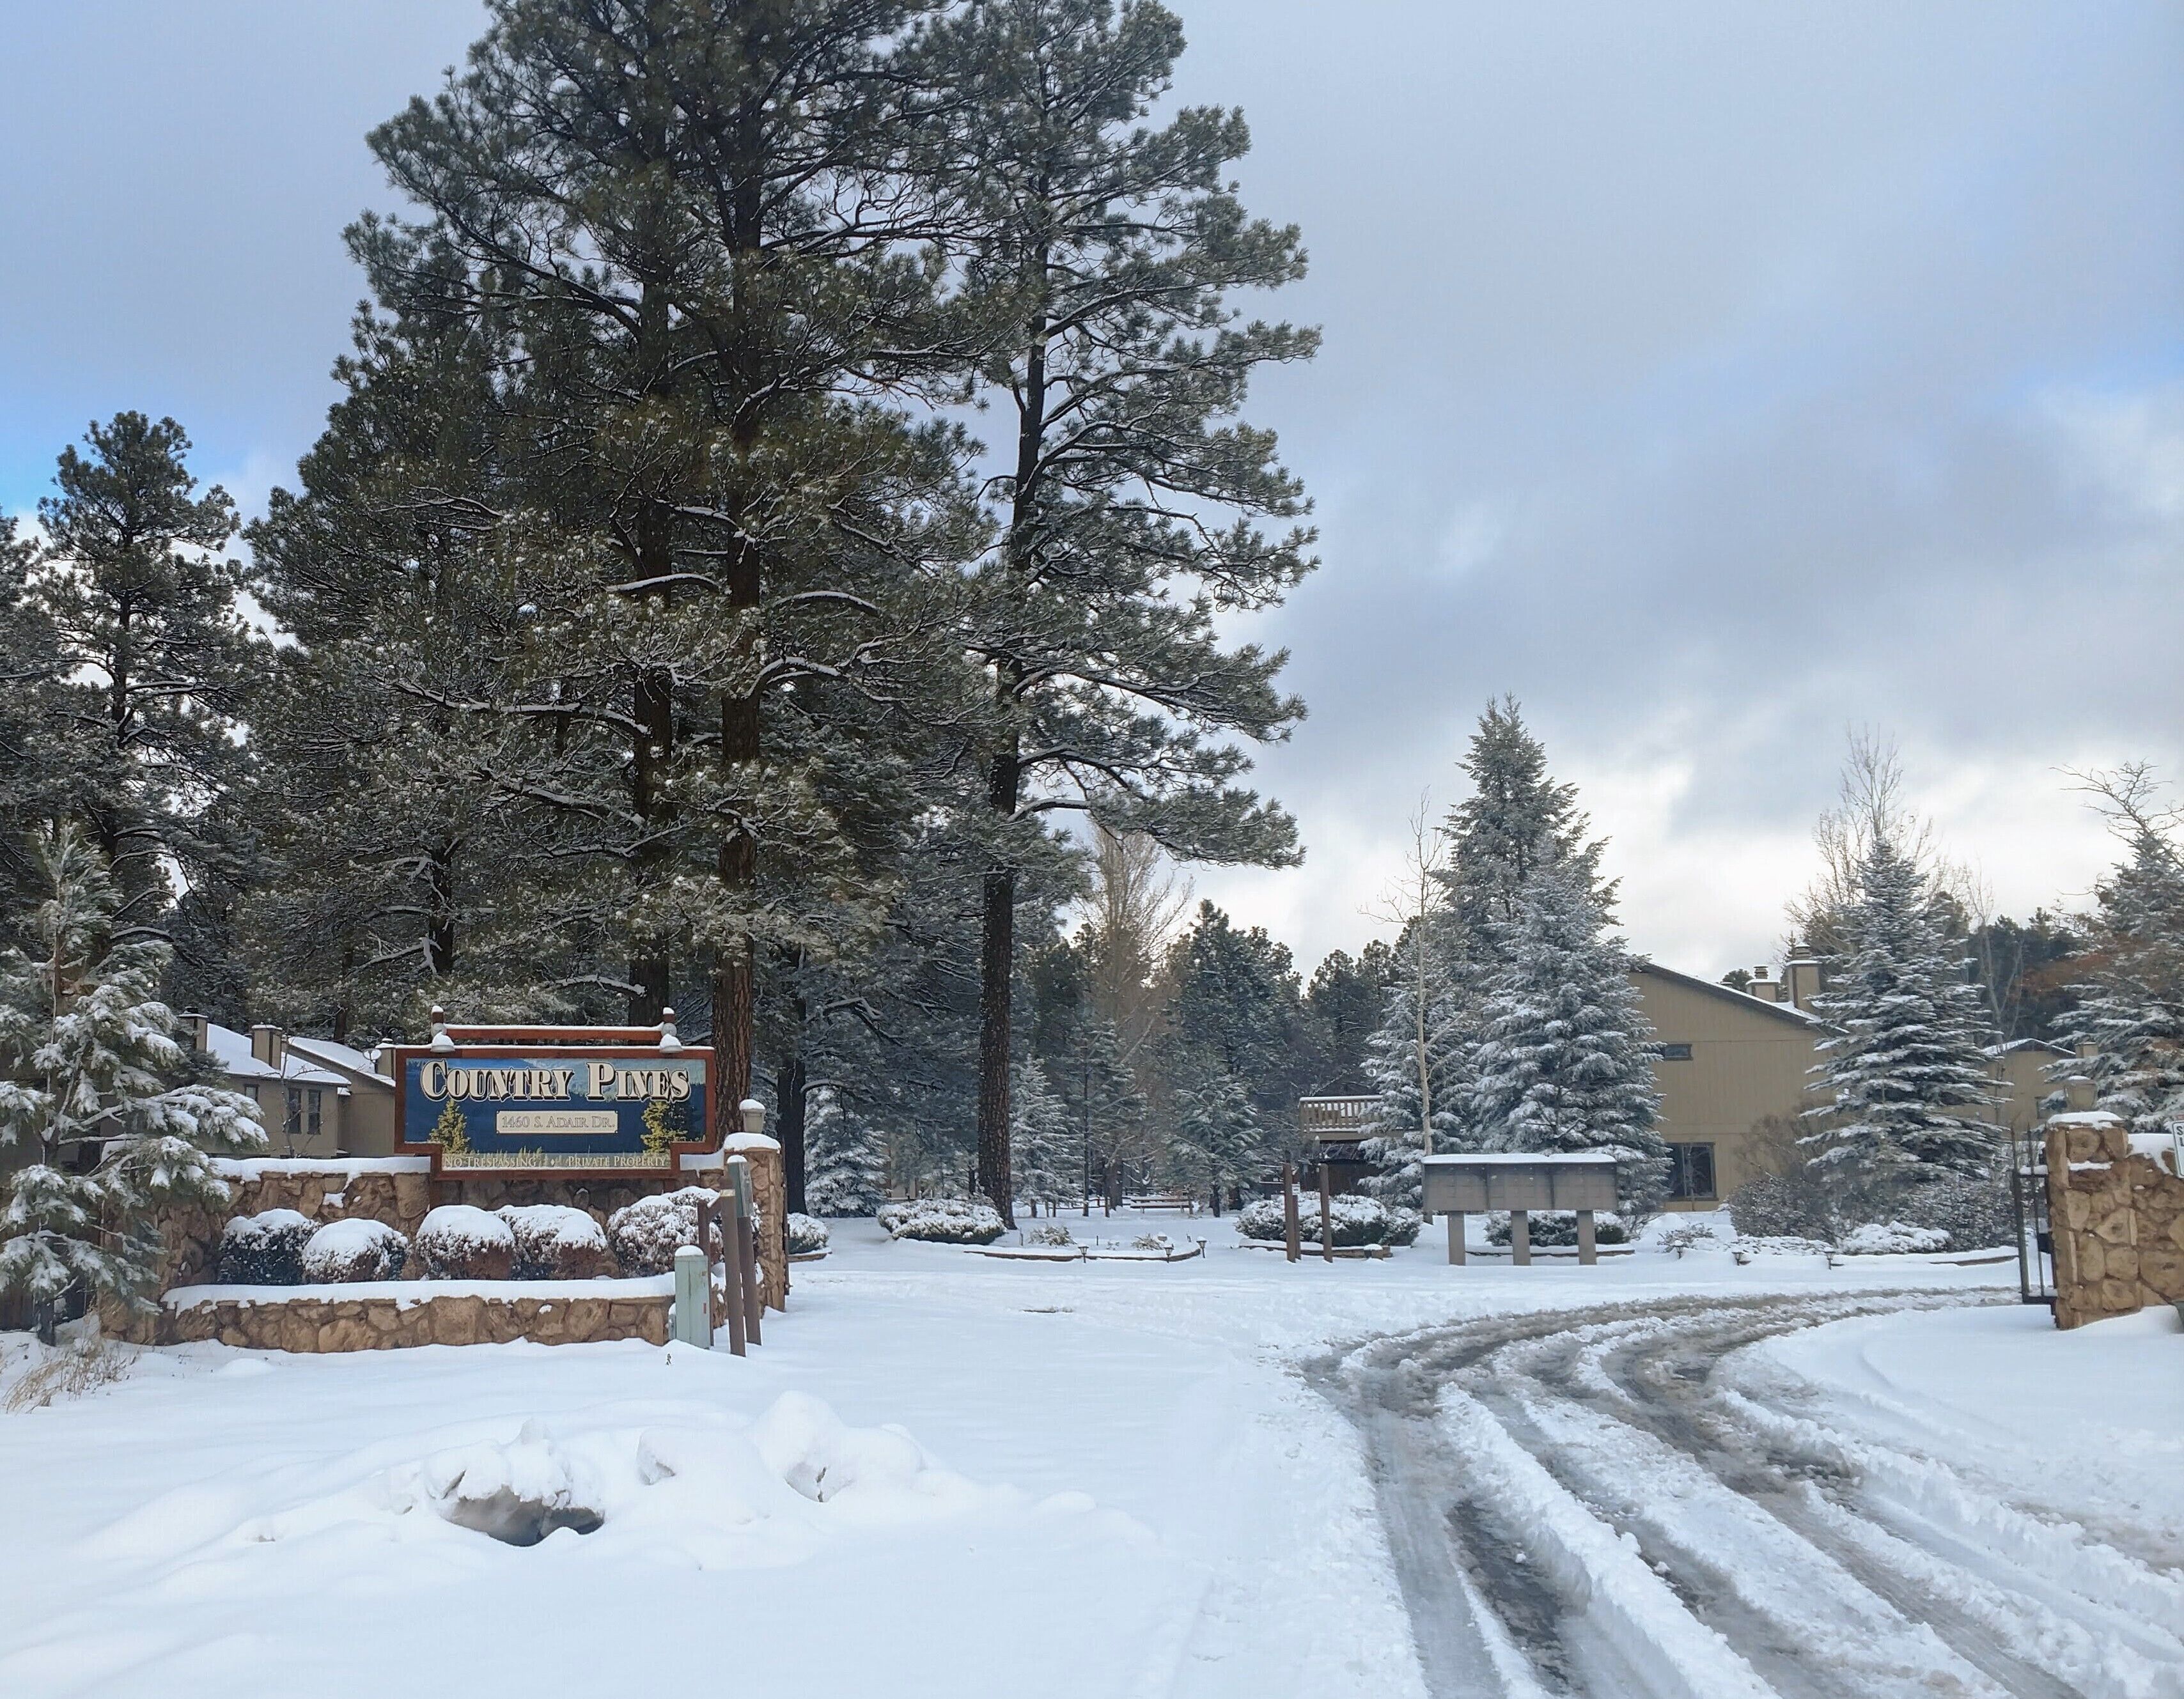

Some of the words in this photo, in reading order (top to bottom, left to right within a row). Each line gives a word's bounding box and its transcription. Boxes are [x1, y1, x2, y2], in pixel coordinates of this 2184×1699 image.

[421, 1059, 574, 1102] COUNTRY
[586, 1062, 691, 1103] PINES
[502, 1116, 530, 1128] 1460
[534, 1115, 543, 1128] S.
[546, 1115, 589, 1128] ADAIR
[591, 1115, 615, 1128] DR.
[444, 1156, 462, 1167] NO
[465, 1156, 536, 1167] TRESPASSING
[568, 1156, 610, 1167] PRIVATE
[614, 1155, 666, 1167] PROPERTY
